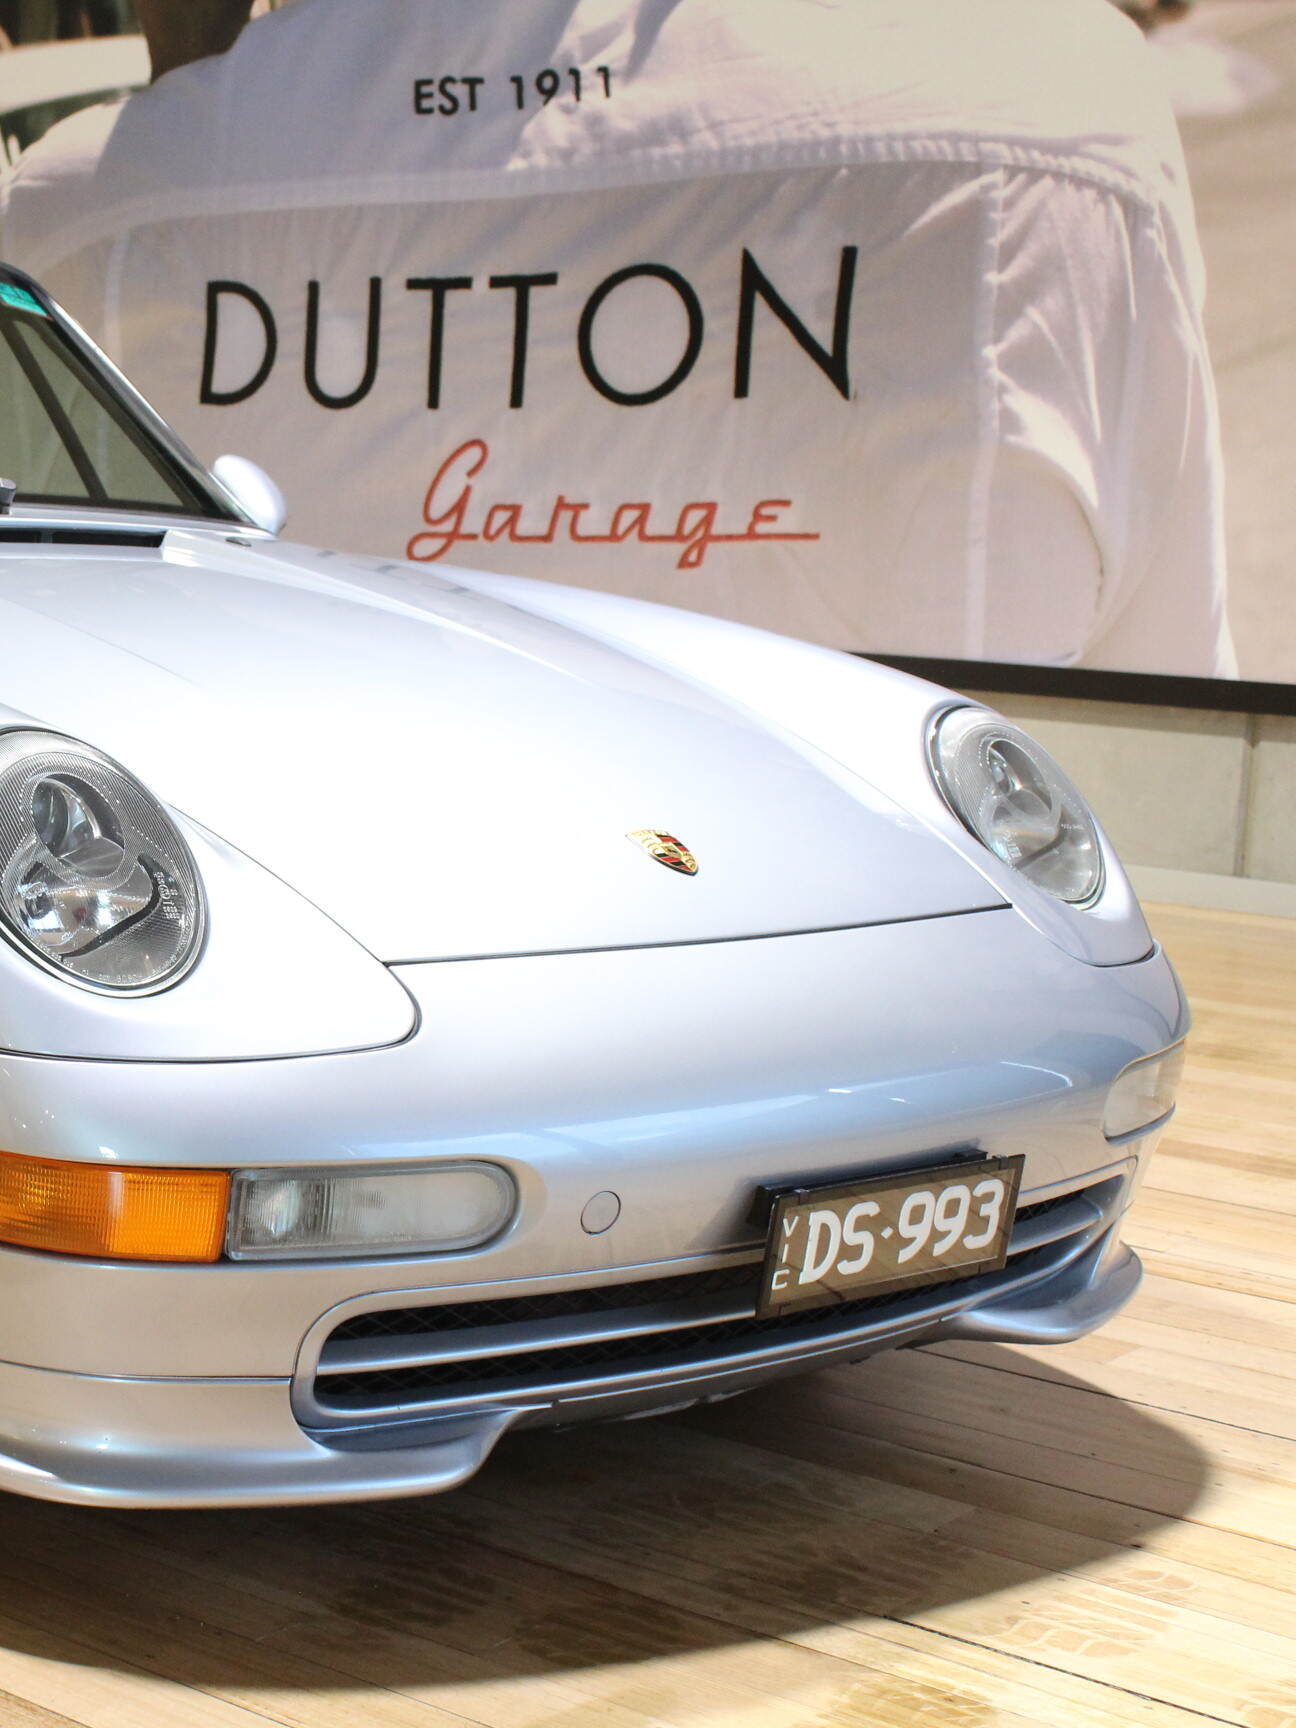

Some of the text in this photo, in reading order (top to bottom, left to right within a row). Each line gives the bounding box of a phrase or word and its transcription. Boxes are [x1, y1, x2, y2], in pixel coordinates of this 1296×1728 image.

[414, 66, 611, 115] EST 1911
[200, 245, 859, 411] DUTTON
[406, 438, 820, 569] Garage
[771, 1216, 799, 1290] VIC
